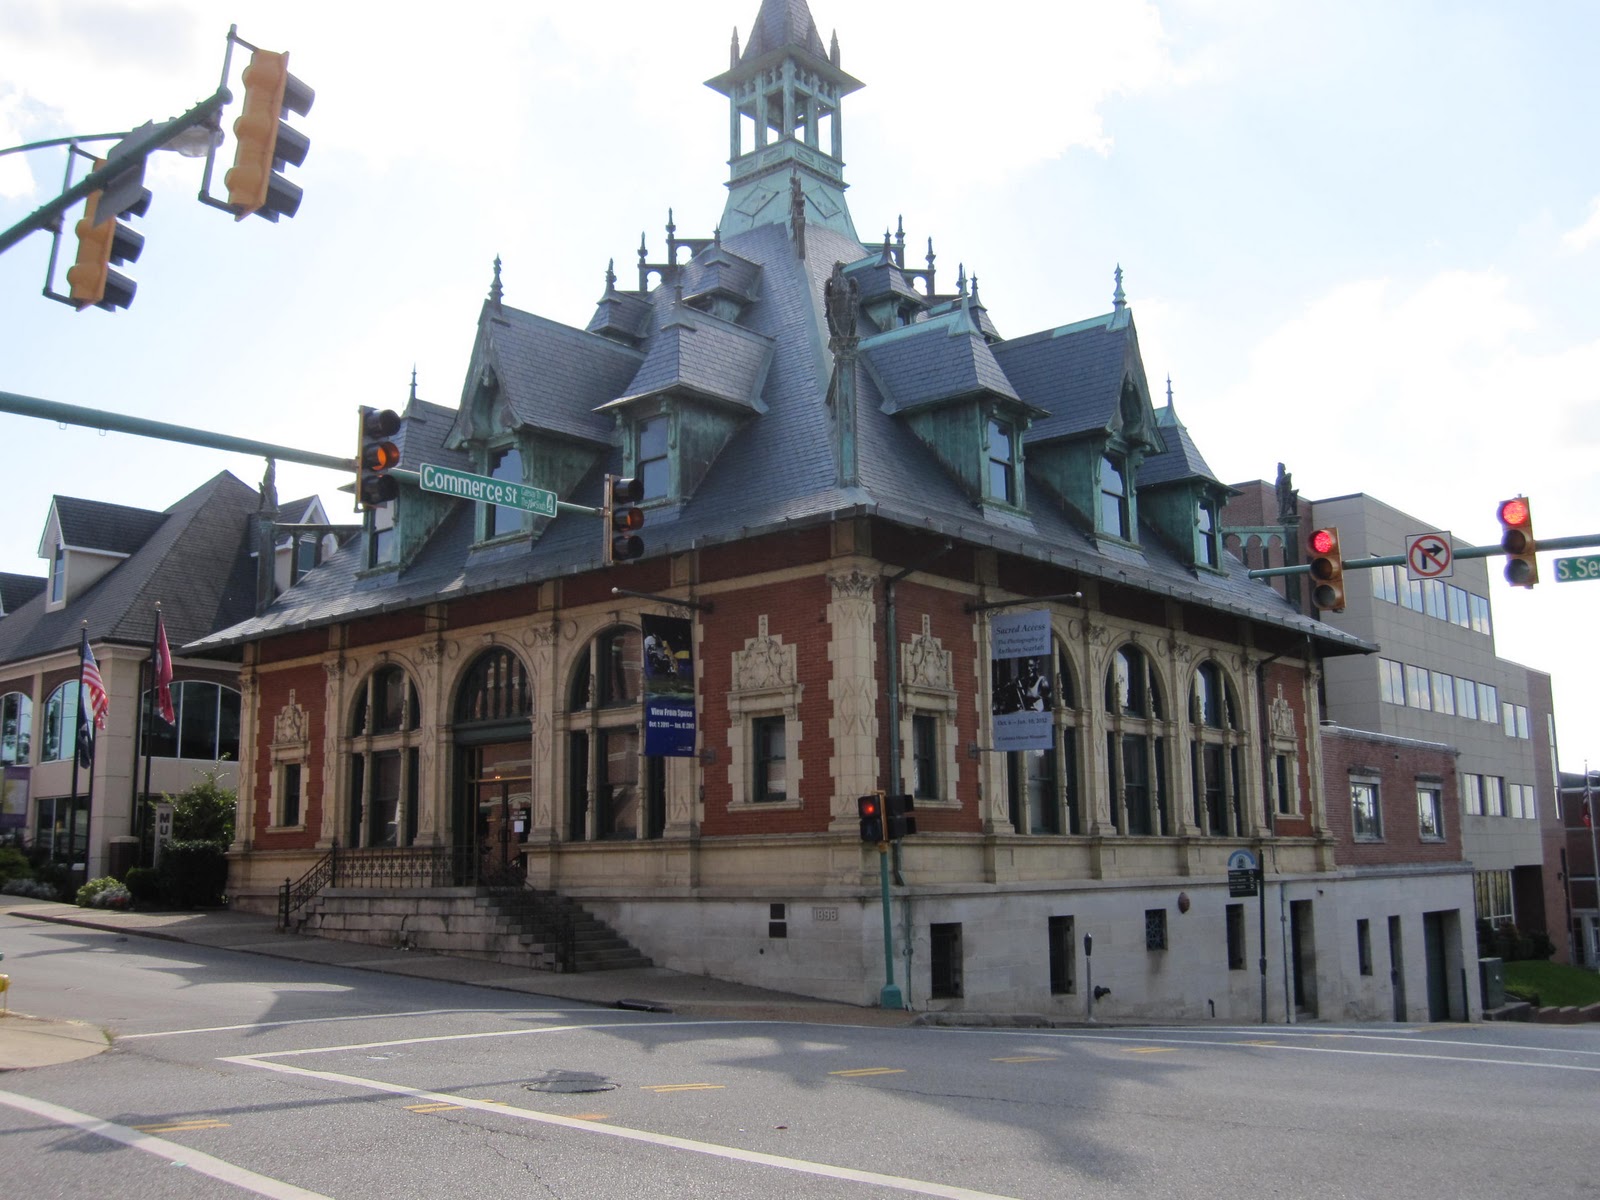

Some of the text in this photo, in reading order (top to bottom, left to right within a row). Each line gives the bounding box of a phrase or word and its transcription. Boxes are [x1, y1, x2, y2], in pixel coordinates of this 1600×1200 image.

[424, 466, 503, 502] Commerce
[504, 486, 518, 504] St
[1557, 558, 1600, 579] S. Se
[996, 624, 1046, 634] Sacred Access
[651, 707, 693, 717] View From Space
[814, 909, 837, 920] 1898
